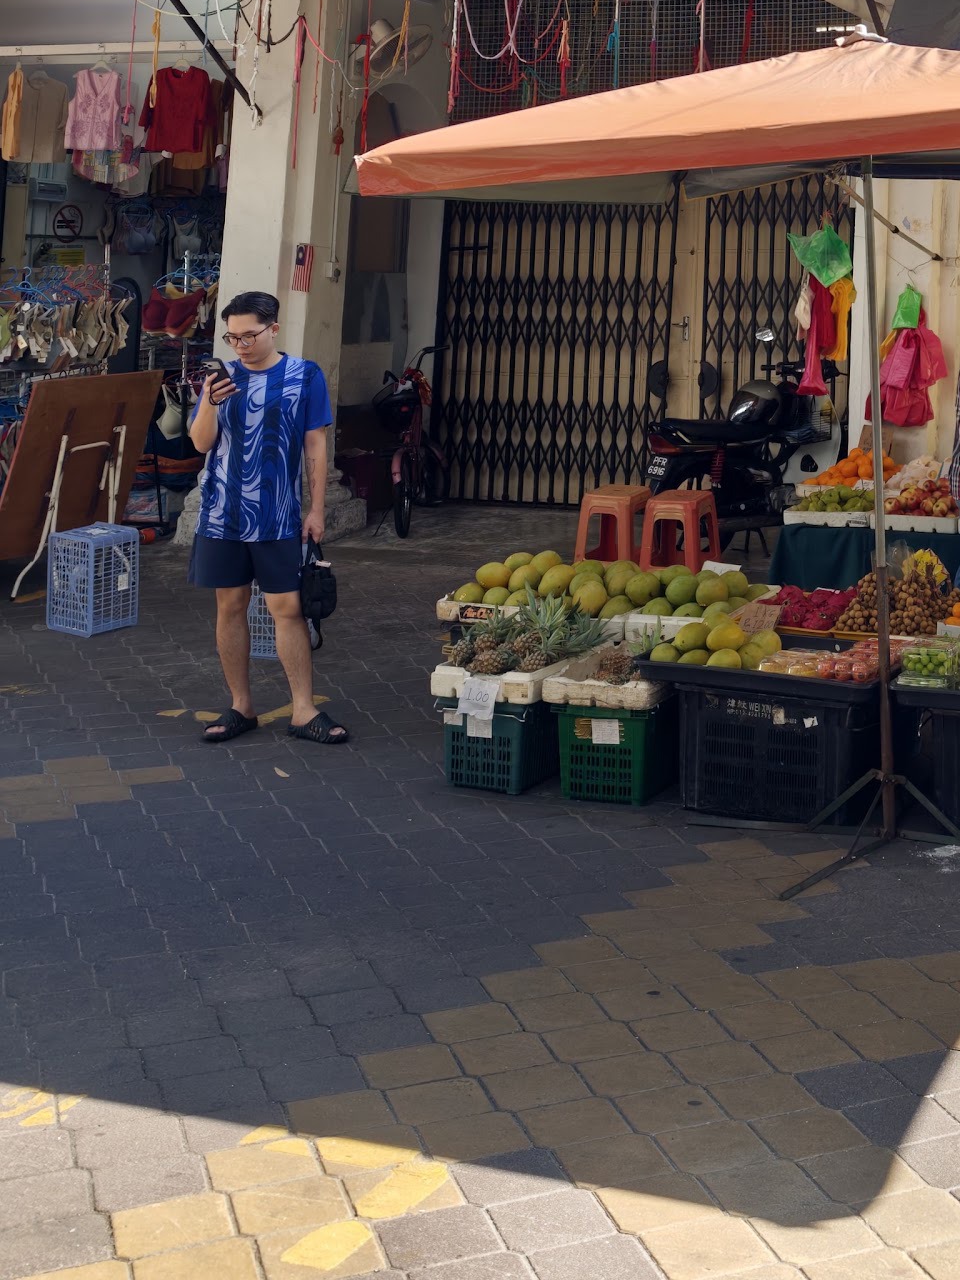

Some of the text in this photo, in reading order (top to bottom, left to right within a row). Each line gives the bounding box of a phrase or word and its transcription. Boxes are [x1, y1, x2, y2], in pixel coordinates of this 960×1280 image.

[652, 456, 668, 466] PFR
[647, 465, 666, 476] 6916
[748, 702, 761, 712] WEI
[762, 704, 772, 714] XIN
